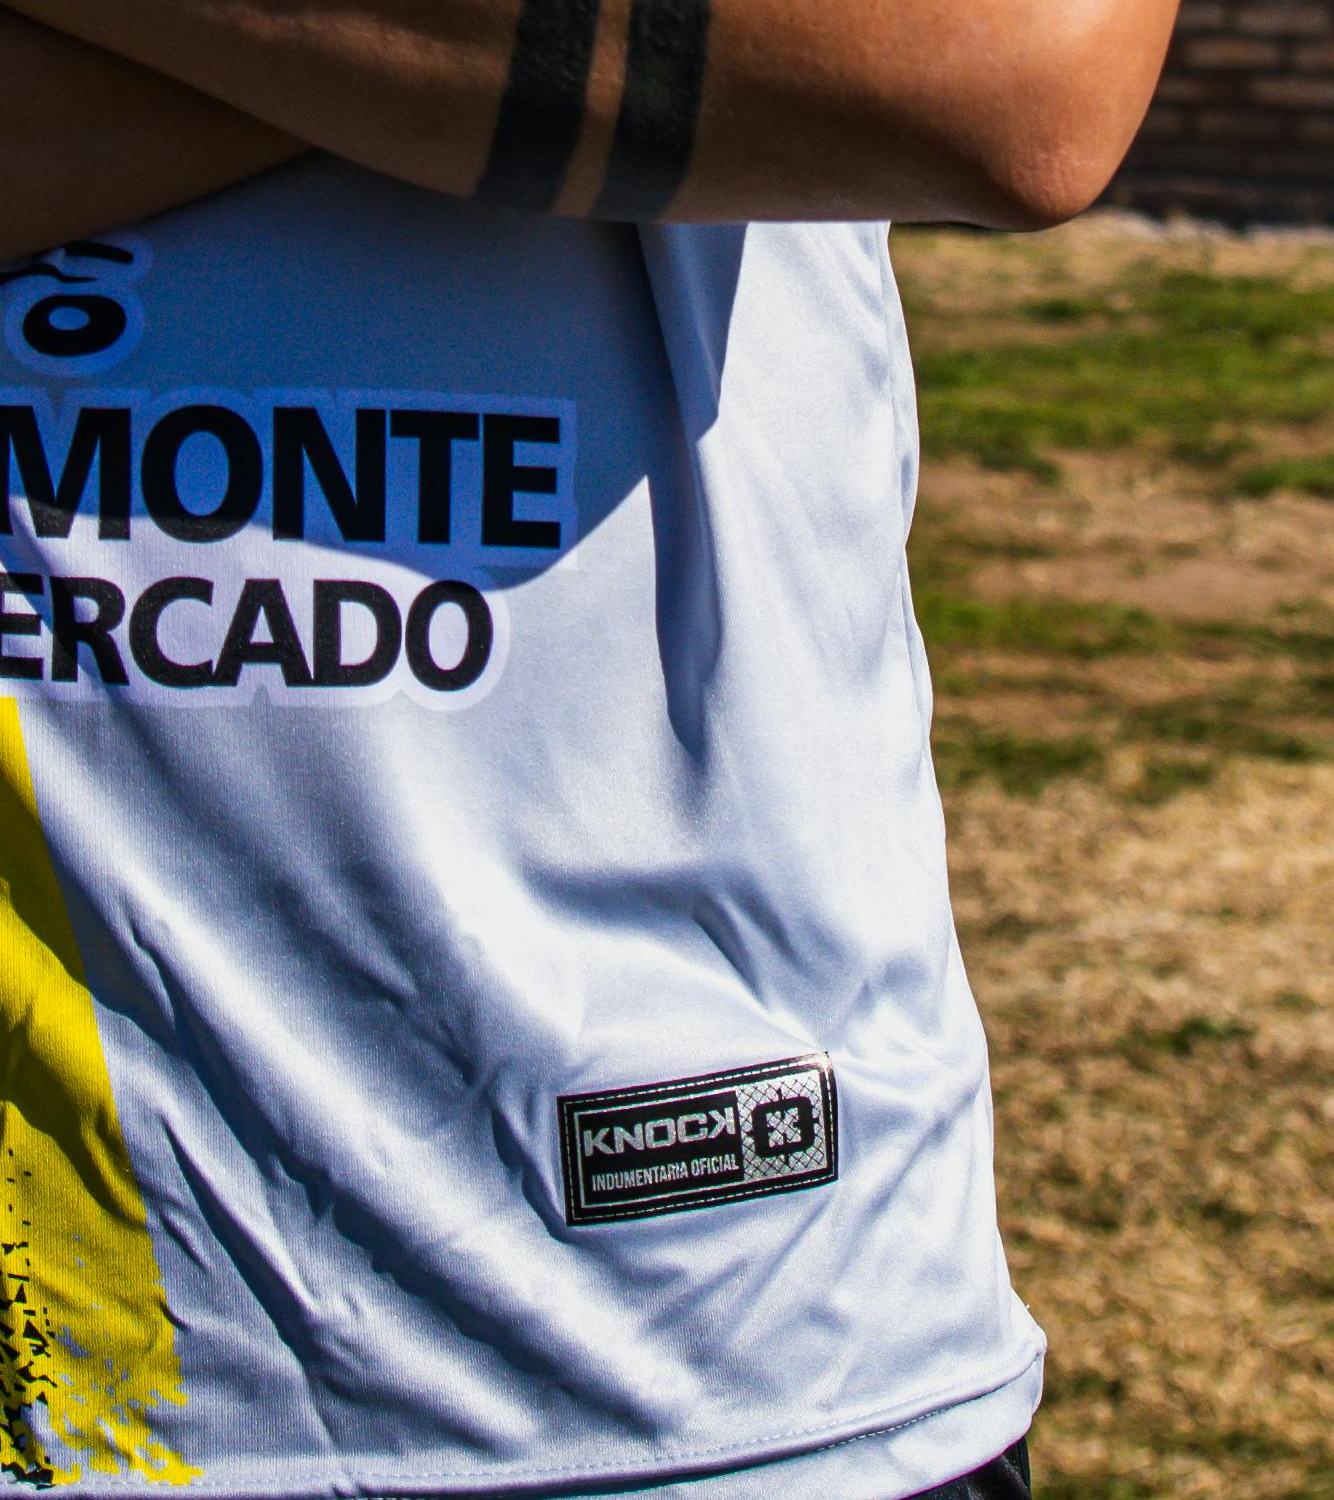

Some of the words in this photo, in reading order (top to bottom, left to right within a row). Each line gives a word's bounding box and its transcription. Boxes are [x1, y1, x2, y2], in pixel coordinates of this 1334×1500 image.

[583, 1106, 736, 1157] KNOCK
[592, 1161, 689, 1192] INDUMENTARIA
[690, 1153, 740, 1177] OFICIAL
